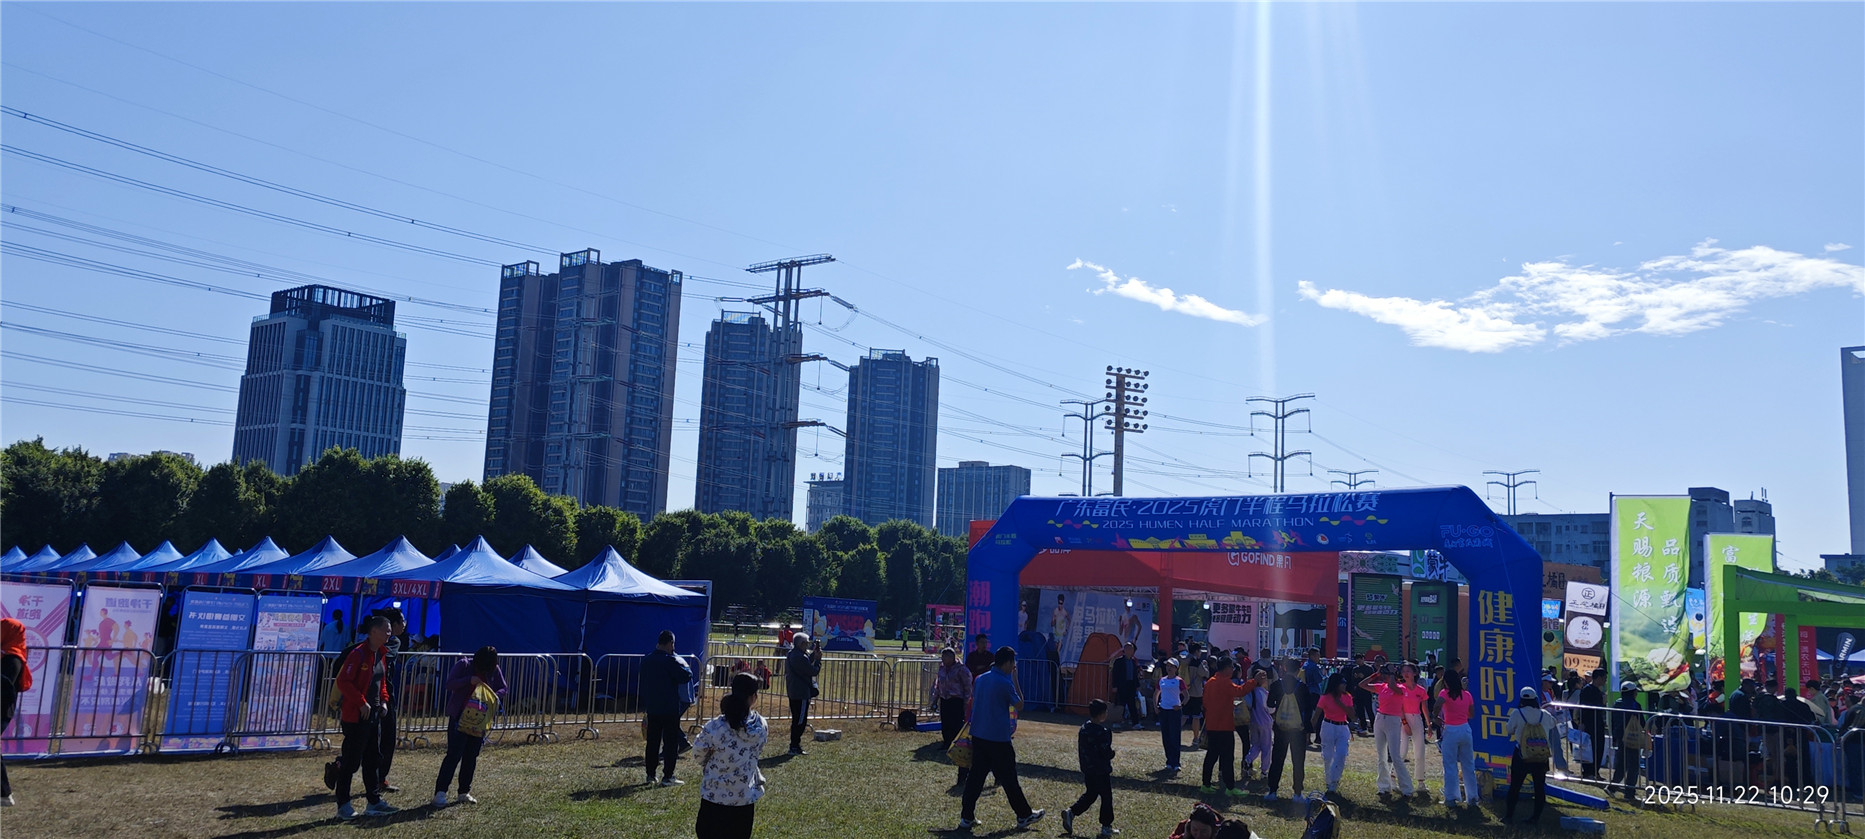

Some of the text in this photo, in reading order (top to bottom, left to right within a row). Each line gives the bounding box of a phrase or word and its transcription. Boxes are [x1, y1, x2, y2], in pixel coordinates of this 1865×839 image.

[1056, 492, 1381, 517] 广东富民·2025虎门半程马拉松赛
[1103, 517, 1315, 529] 2025 HUMEN HALF MARATHON
[1240, 551, 1275, 567] GOFIND
[256, 575, 266, 587] XL
[322, 578, 340, 591] 2XL
[393, 582, 428, 596] 3XL/4XL
[1478, 590, 1516, 742] 健康时尚
[1564, 656, 1580, 668] 09
